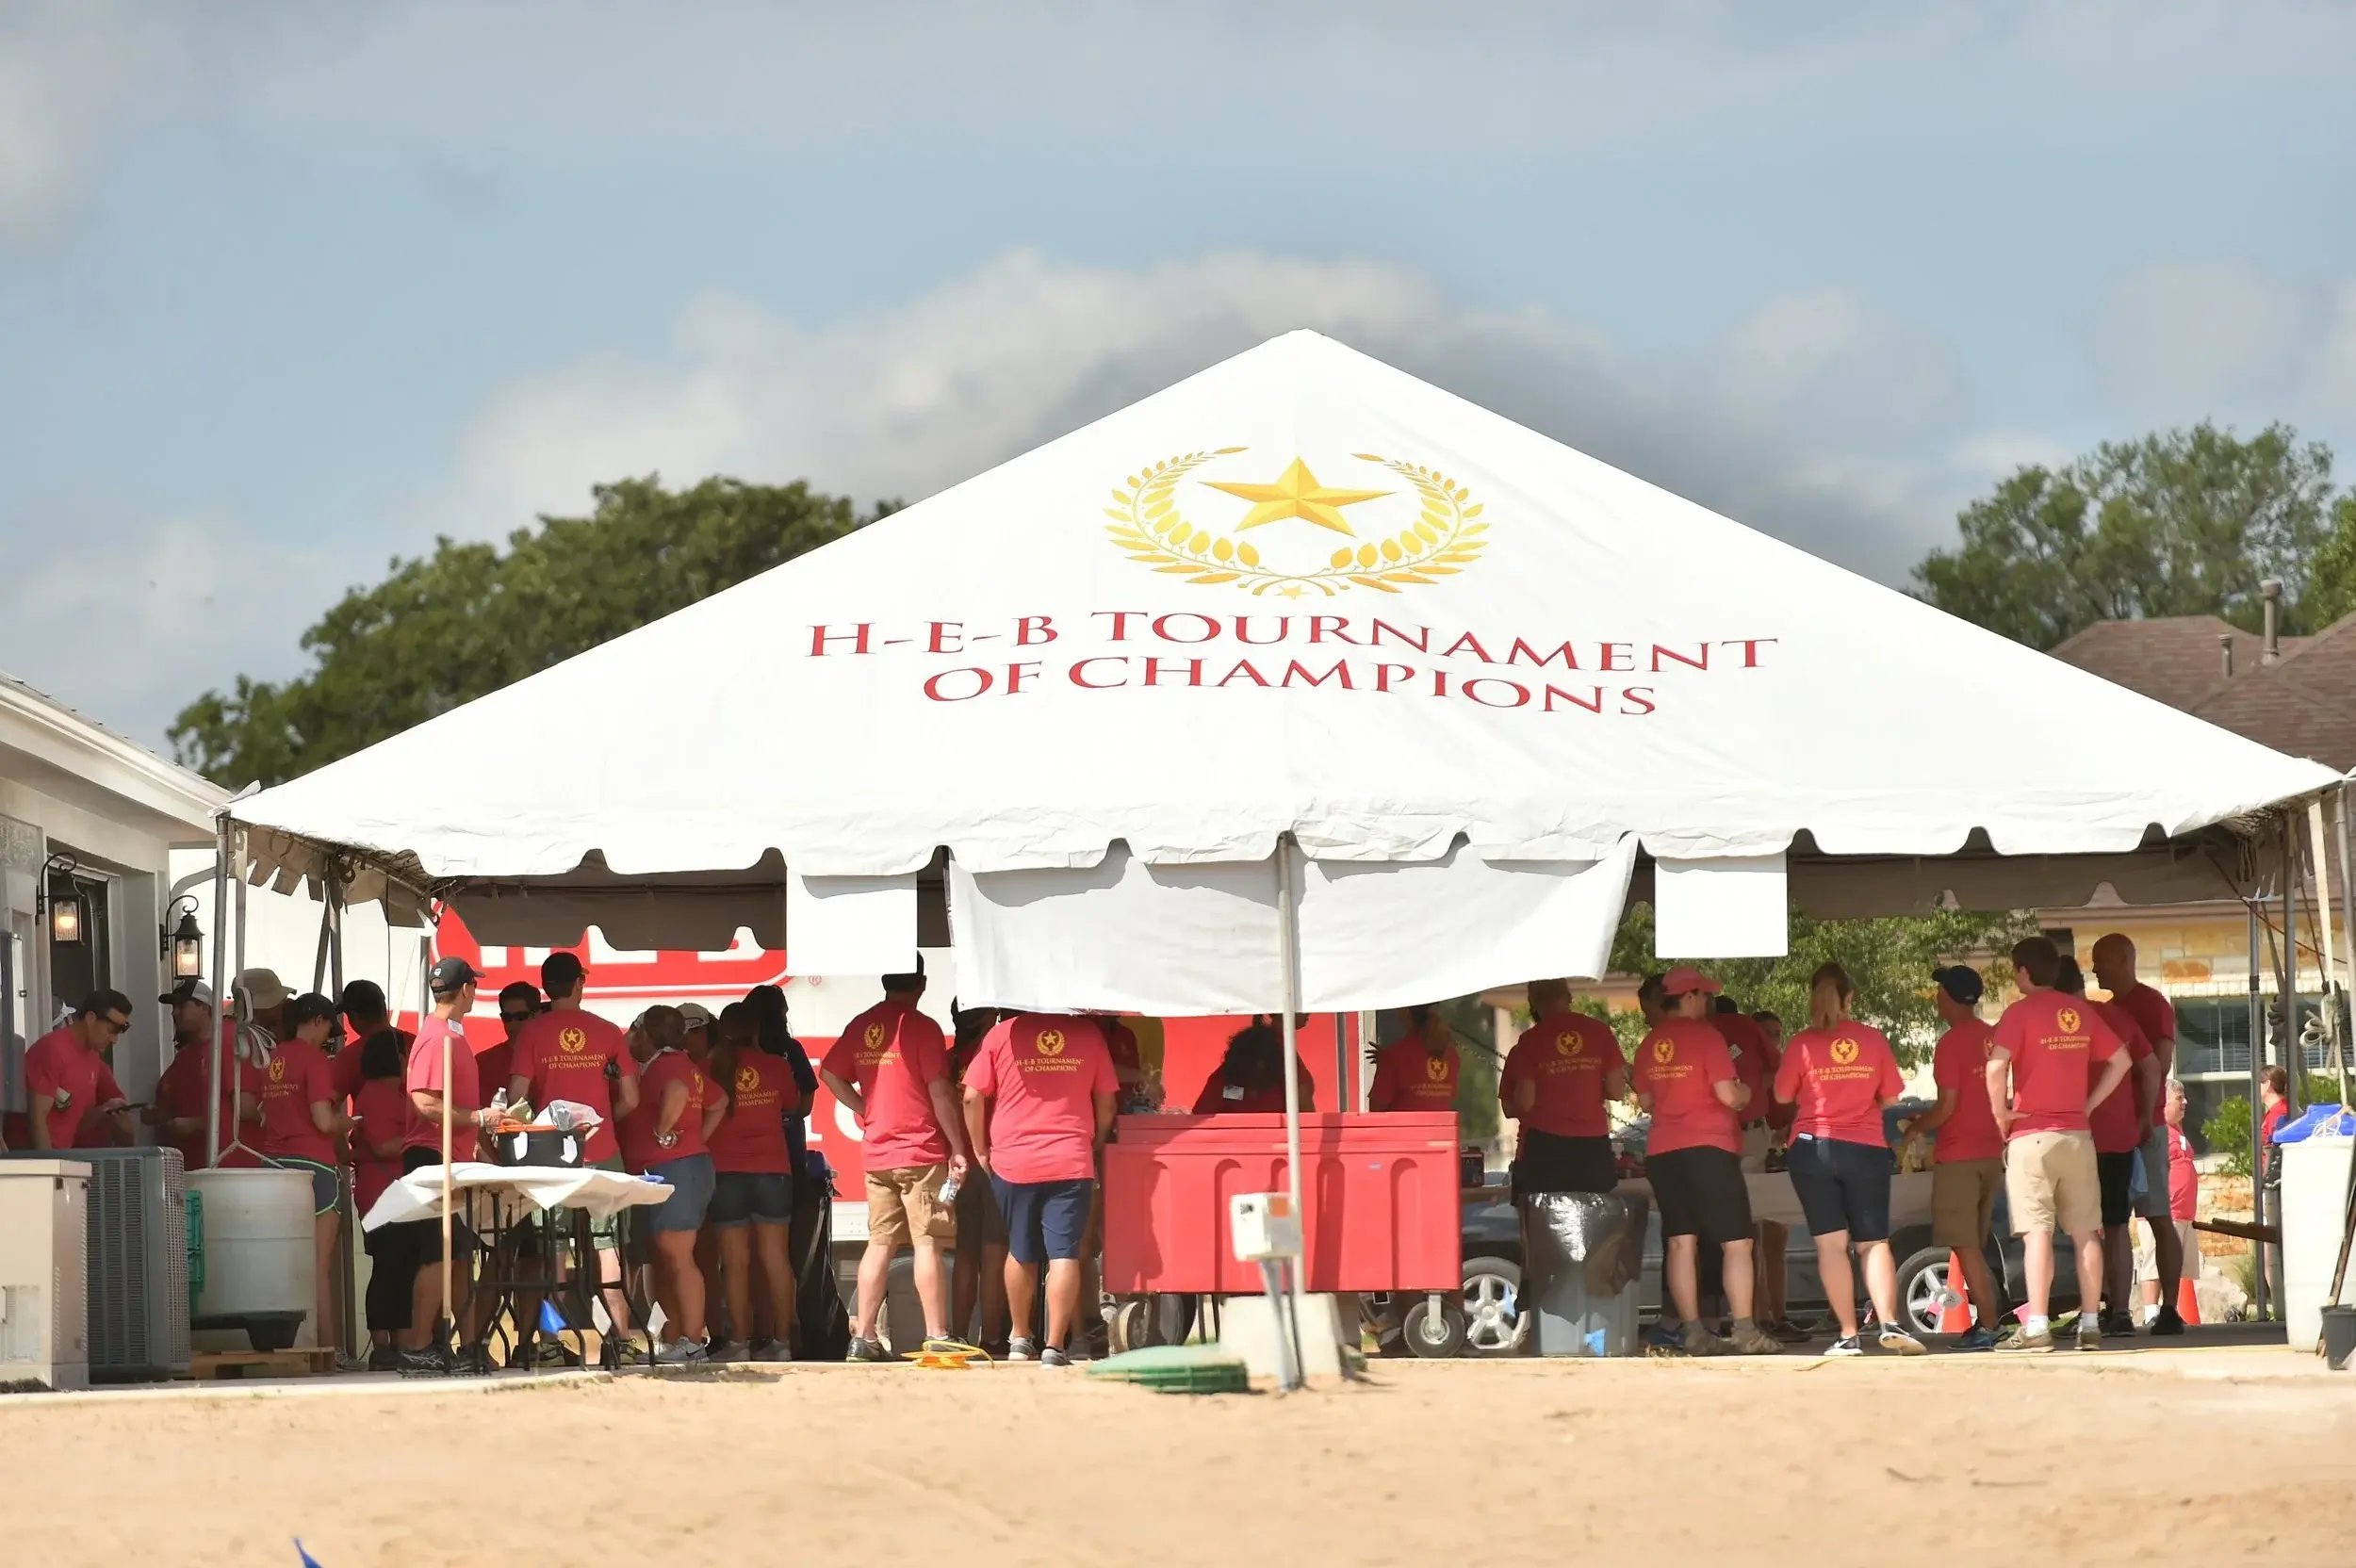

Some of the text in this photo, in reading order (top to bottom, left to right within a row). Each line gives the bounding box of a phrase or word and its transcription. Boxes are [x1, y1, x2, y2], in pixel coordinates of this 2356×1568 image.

[805, 611, 1779, 673] H-E-B TOURNAMENT
[923, 656, 1657, 715] OF CHAMPIONS
